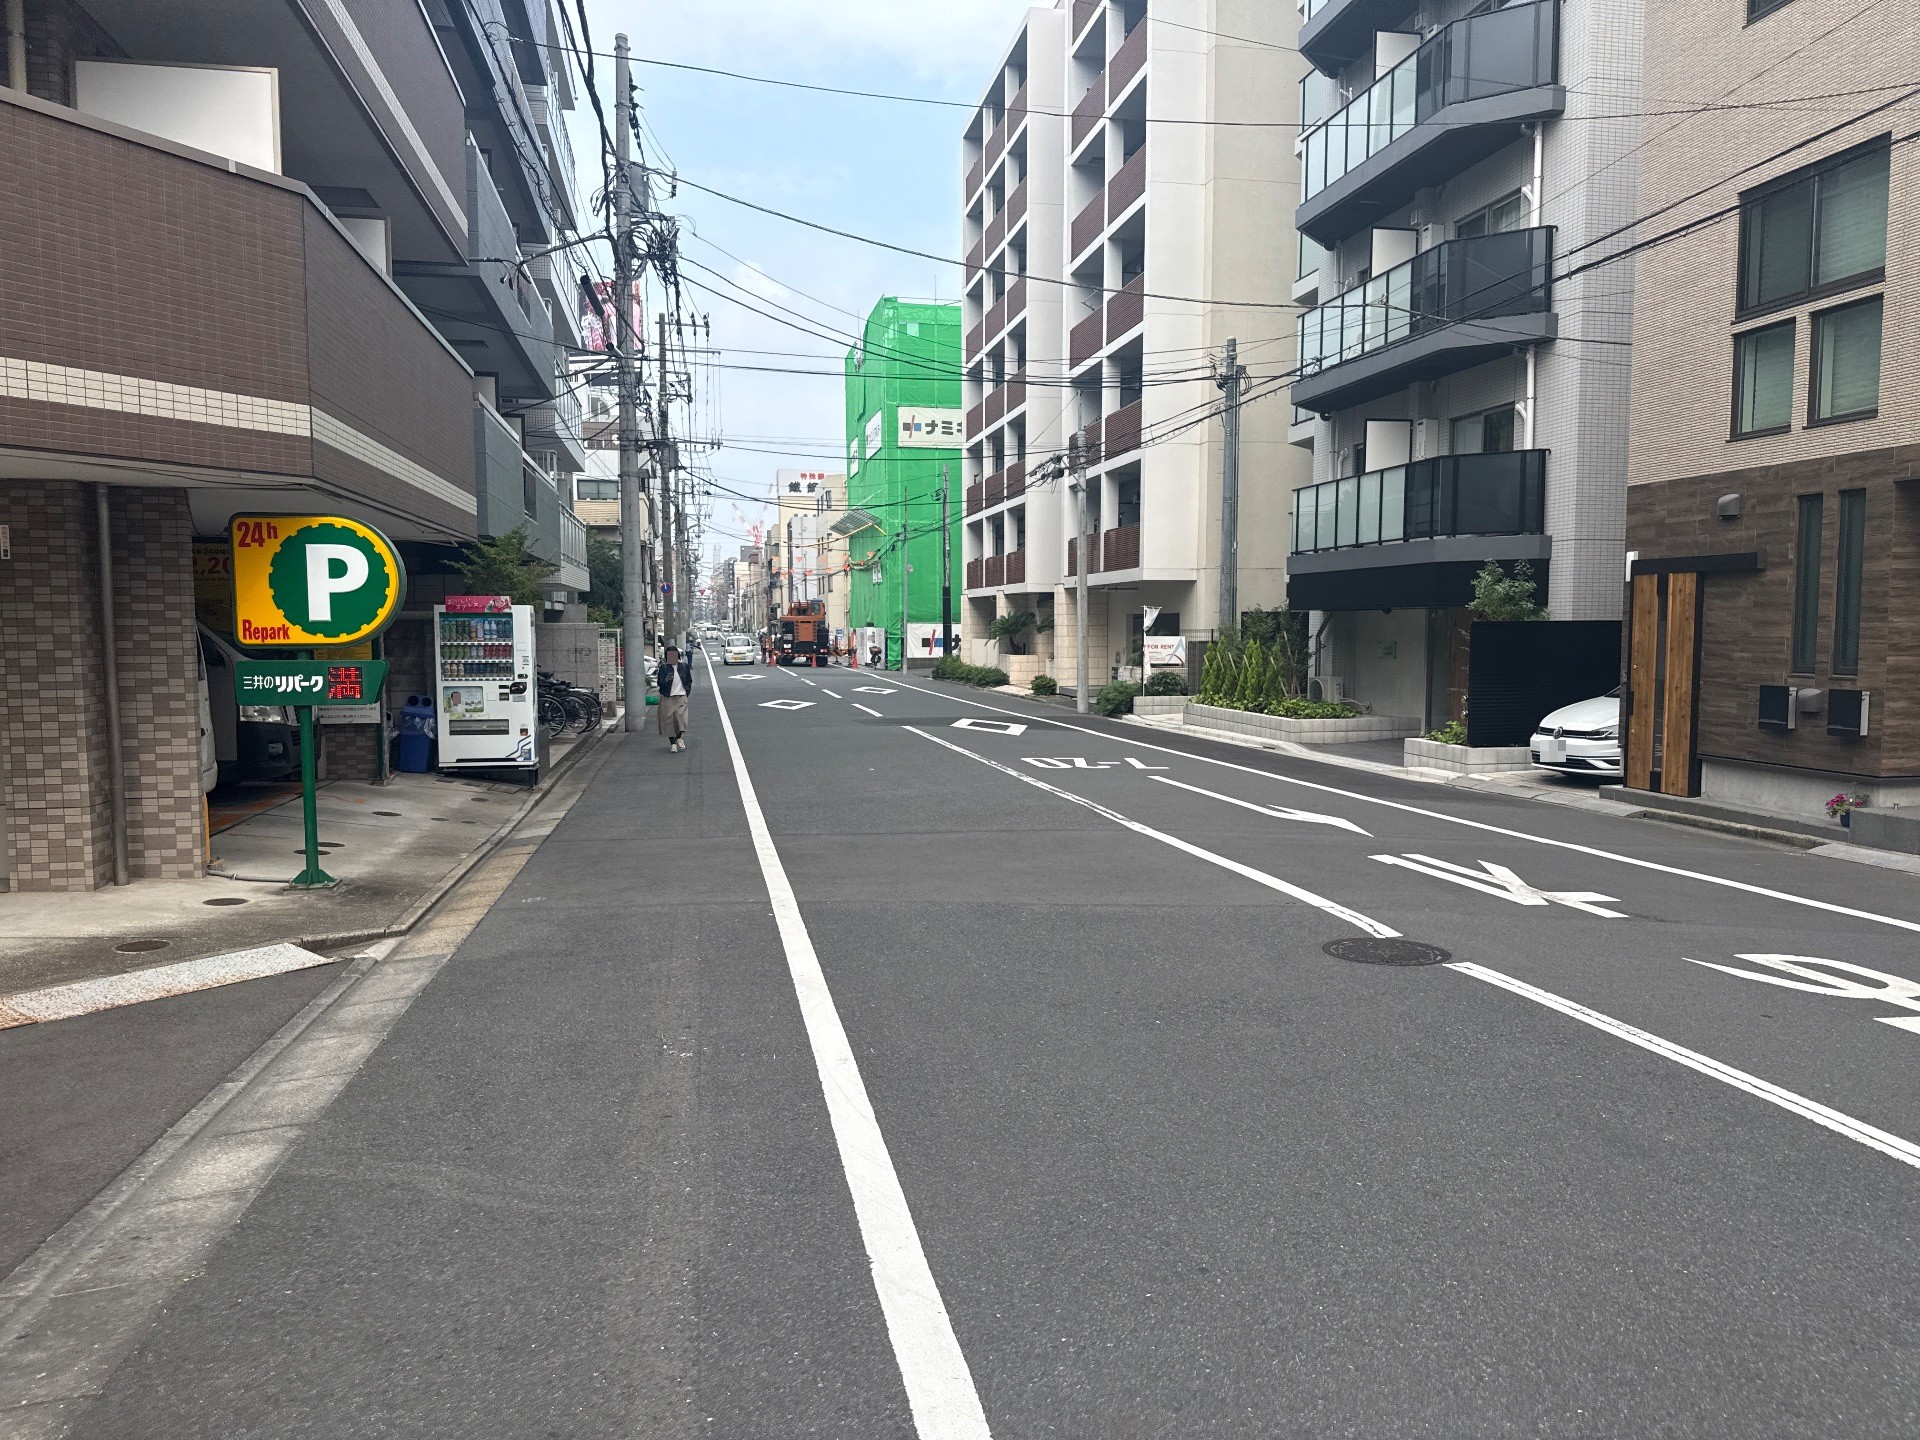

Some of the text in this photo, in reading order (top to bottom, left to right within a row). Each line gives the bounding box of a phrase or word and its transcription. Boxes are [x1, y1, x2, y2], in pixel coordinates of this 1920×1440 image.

[236, 521, 279, 548] 24h
[305, 543, 369, 623] P
[242, 619, 291, 642] Repark
[242, 674, 324, 693] 三井のリパーク
